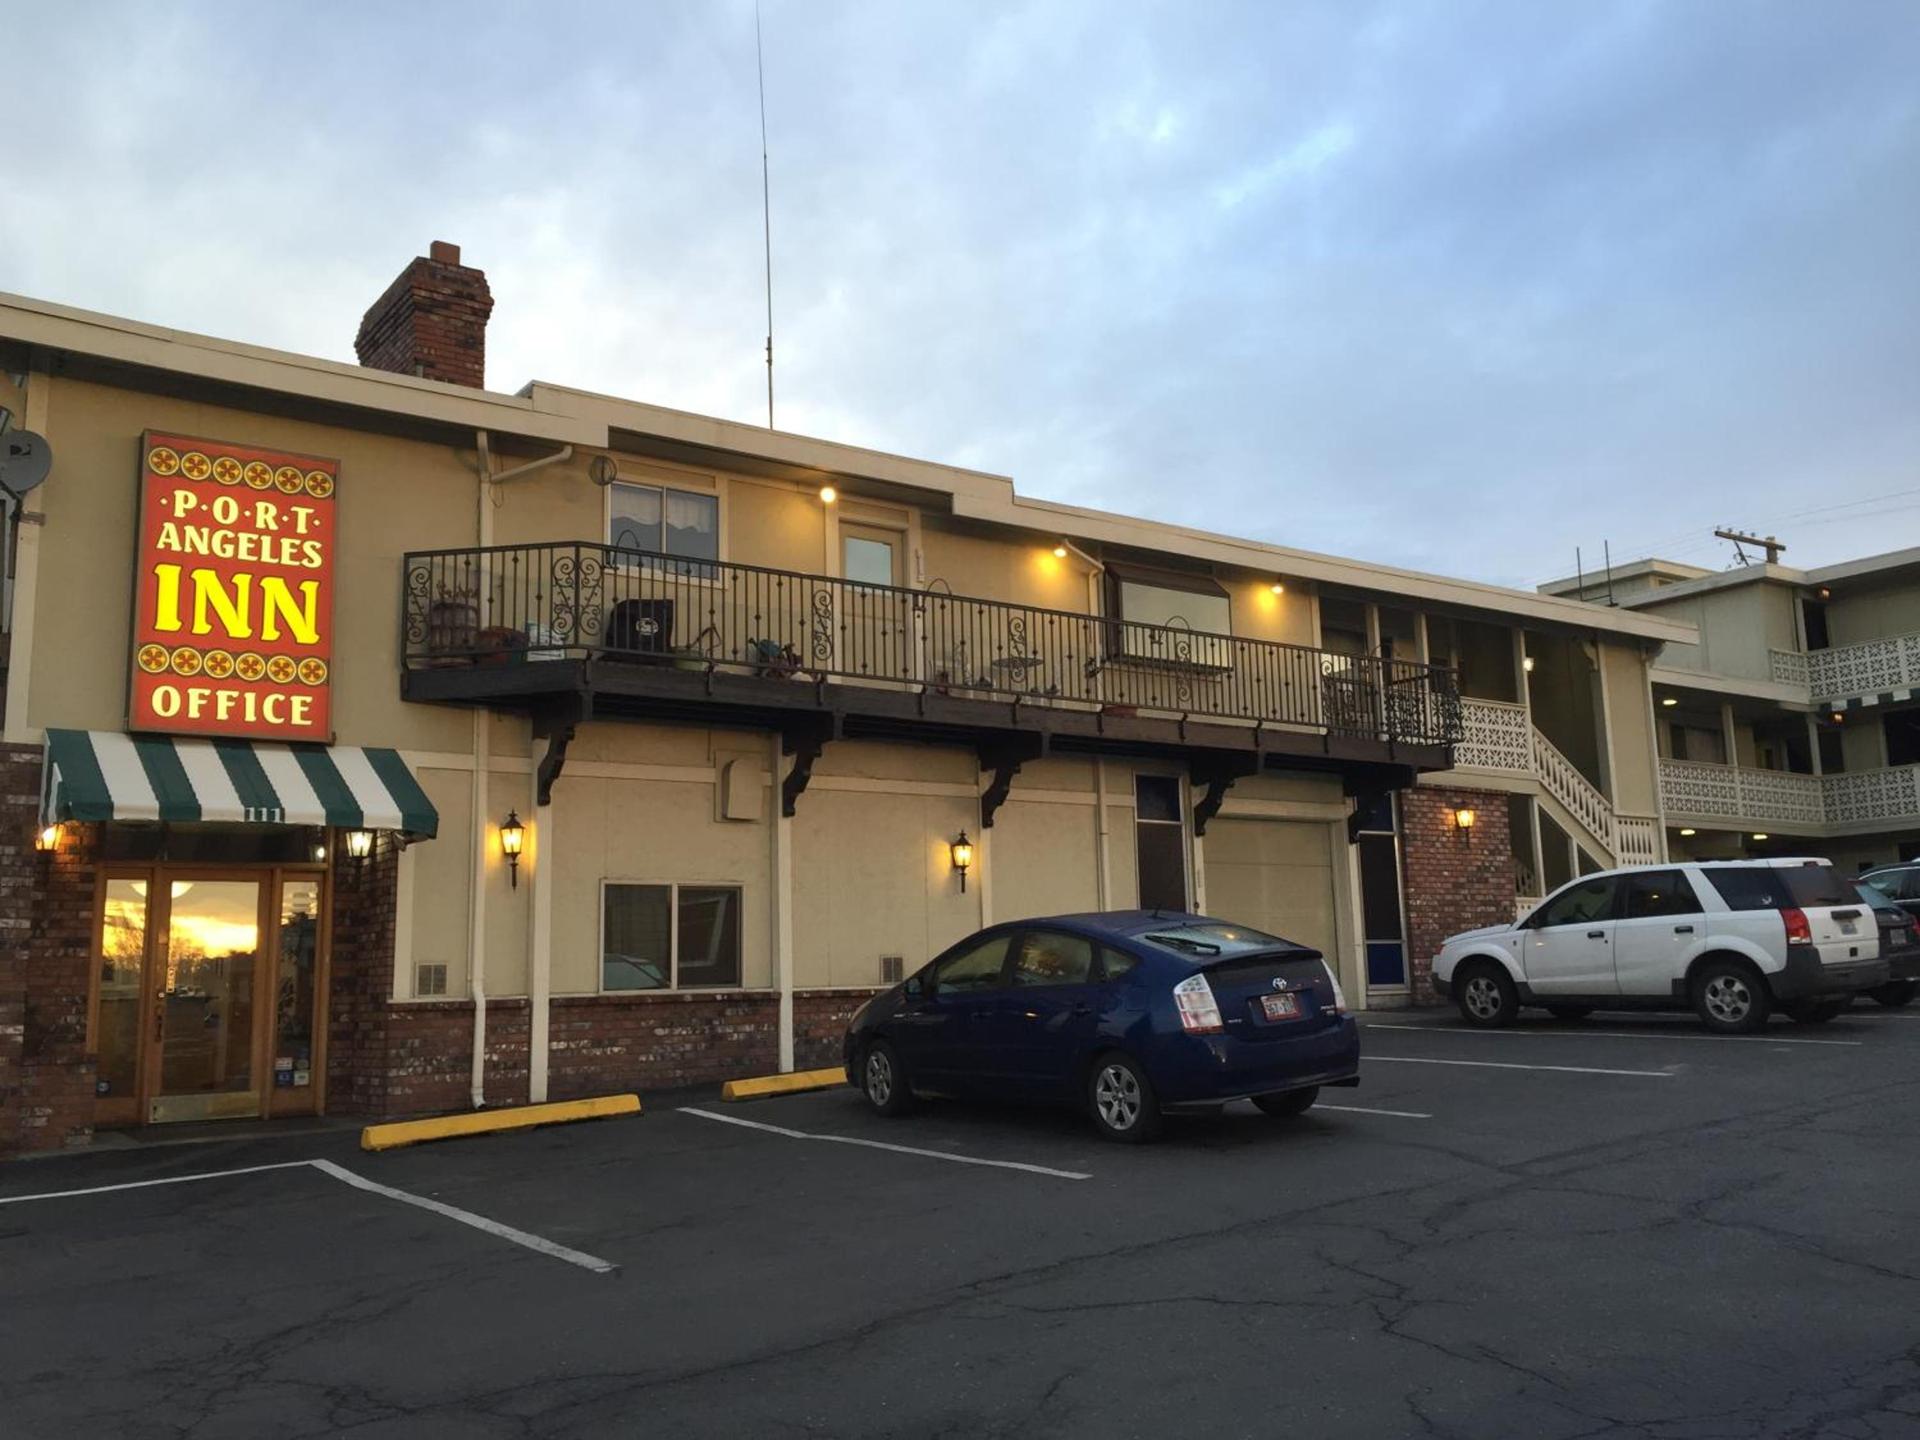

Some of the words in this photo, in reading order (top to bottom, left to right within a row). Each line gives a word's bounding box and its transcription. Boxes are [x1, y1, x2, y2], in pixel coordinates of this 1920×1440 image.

[156, 521, 323, 569] ANGELES
[154, 563, 321, 645] INN
[151, 685, 313, 726] OFFICE
[245, 807, 282, 824] 111
